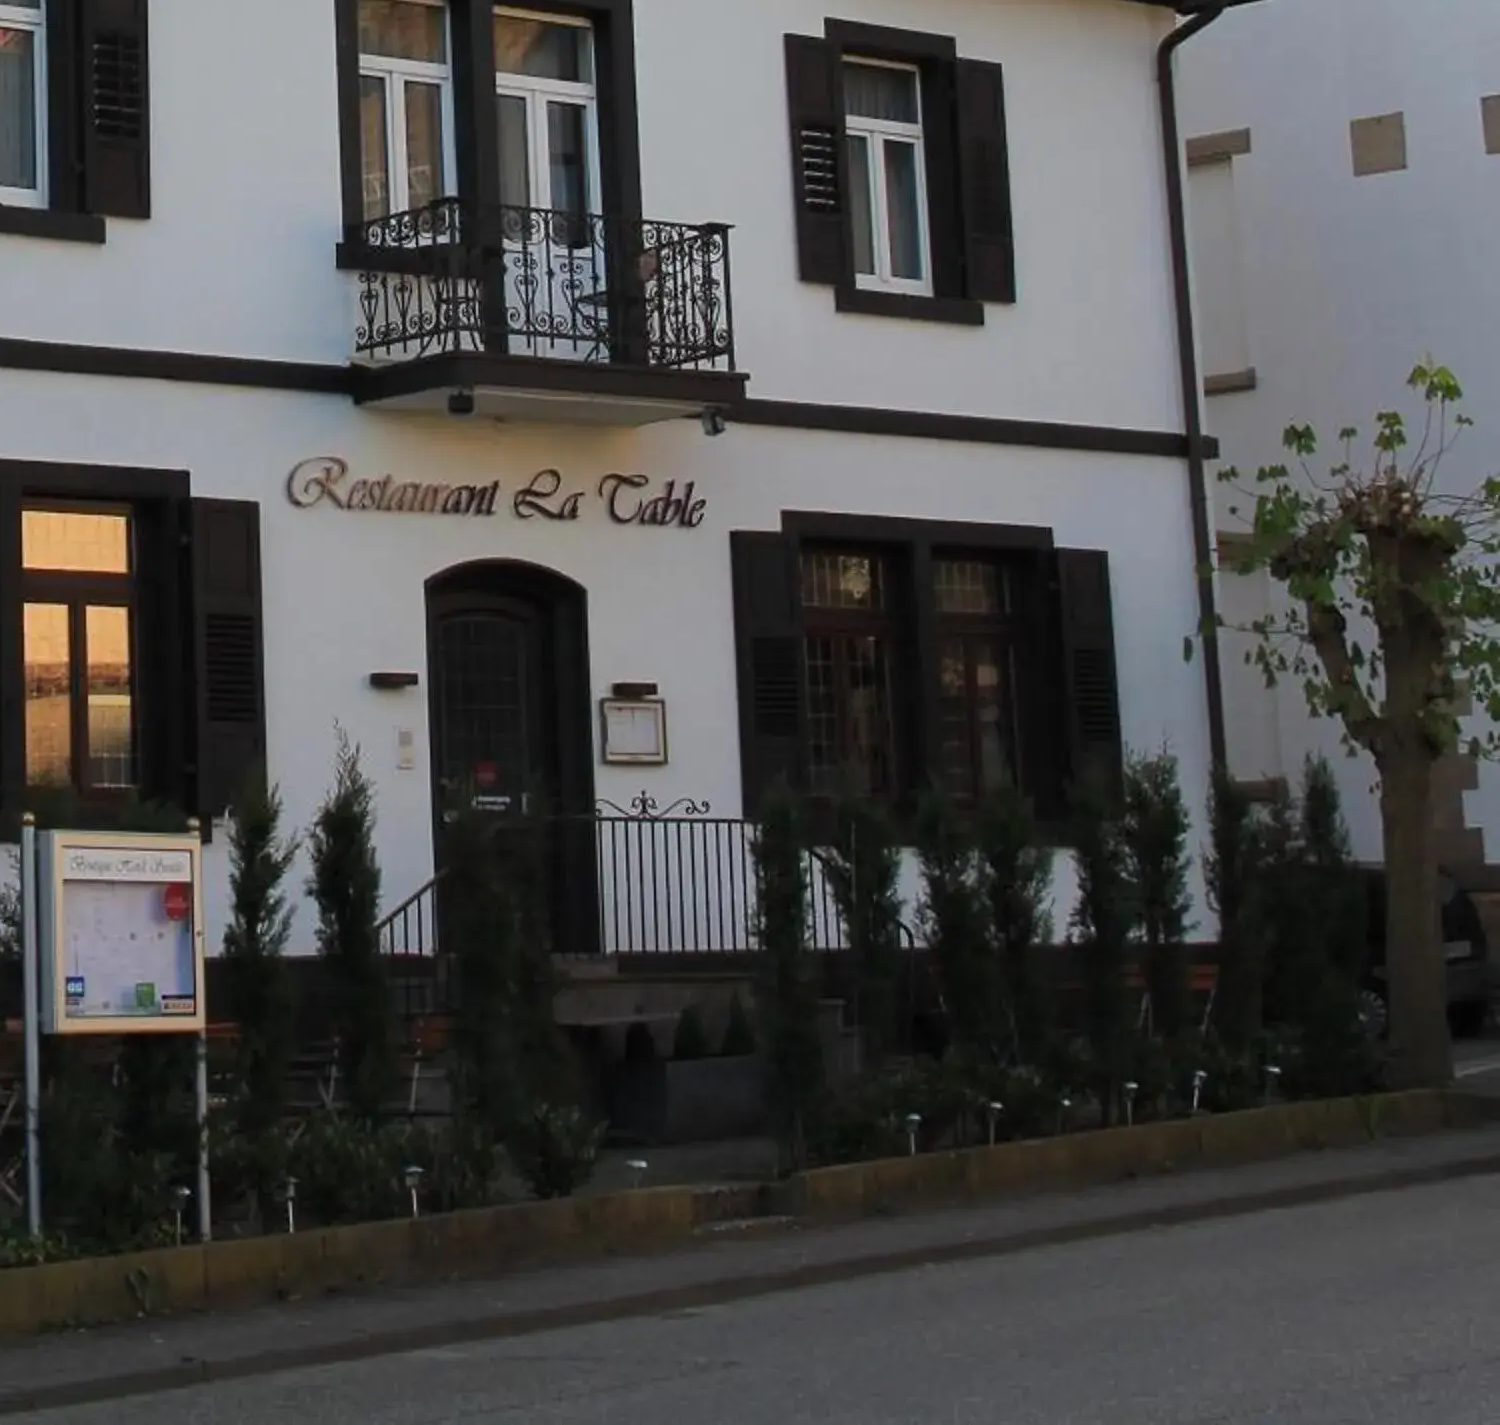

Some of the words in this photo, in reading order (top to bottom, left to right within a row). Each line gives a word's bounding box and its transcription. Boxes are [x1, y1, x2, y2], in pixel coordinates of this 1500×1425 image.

[286, 455, 500, 517] Restaurant
[513, 468, 586, 522] La
[597, 473, 707, 529] Table
